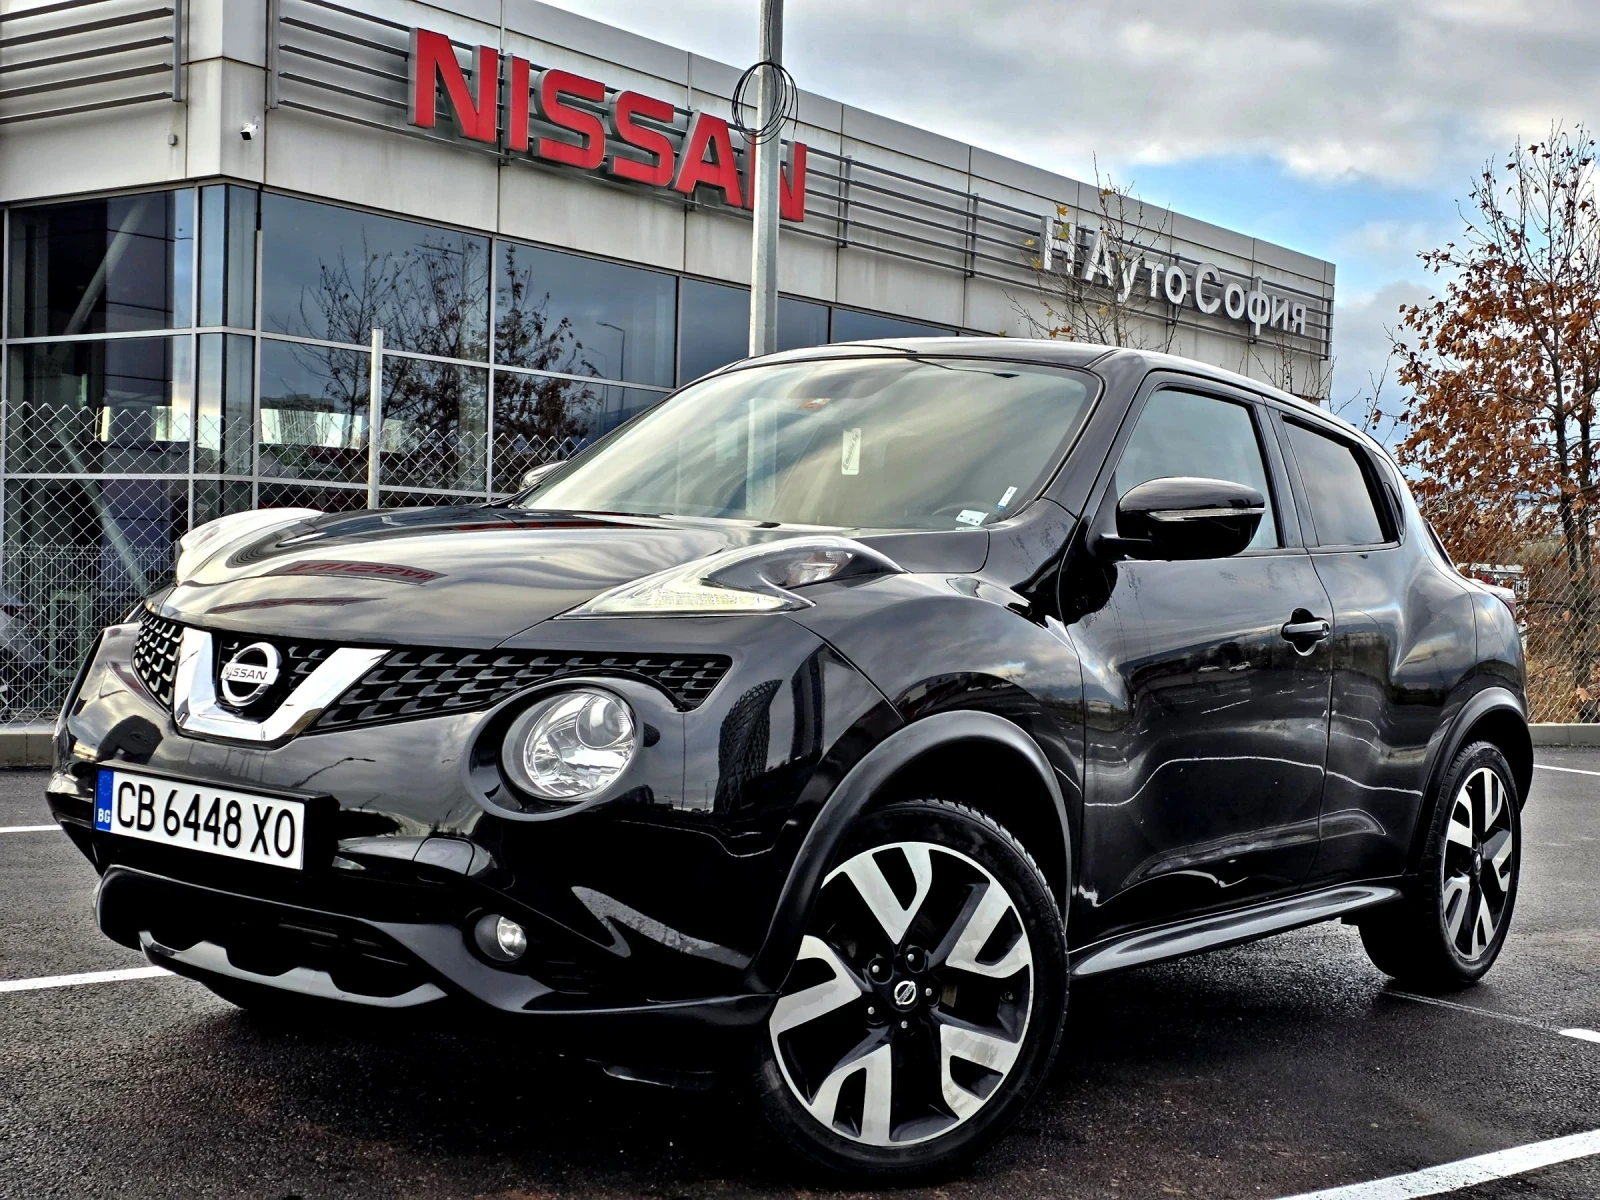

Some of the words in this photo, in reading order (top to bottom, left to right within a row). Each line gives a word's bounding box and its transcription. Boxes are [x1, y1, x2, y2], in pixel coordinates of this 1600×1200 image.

[409, 27, 807, 222] NISSAN
[223, 666, 268, 680] NISSAN
[97, 808, 111, 824] BG
[117, 781, 155, 832] CB
[163, 789, 242, 849] 6448
